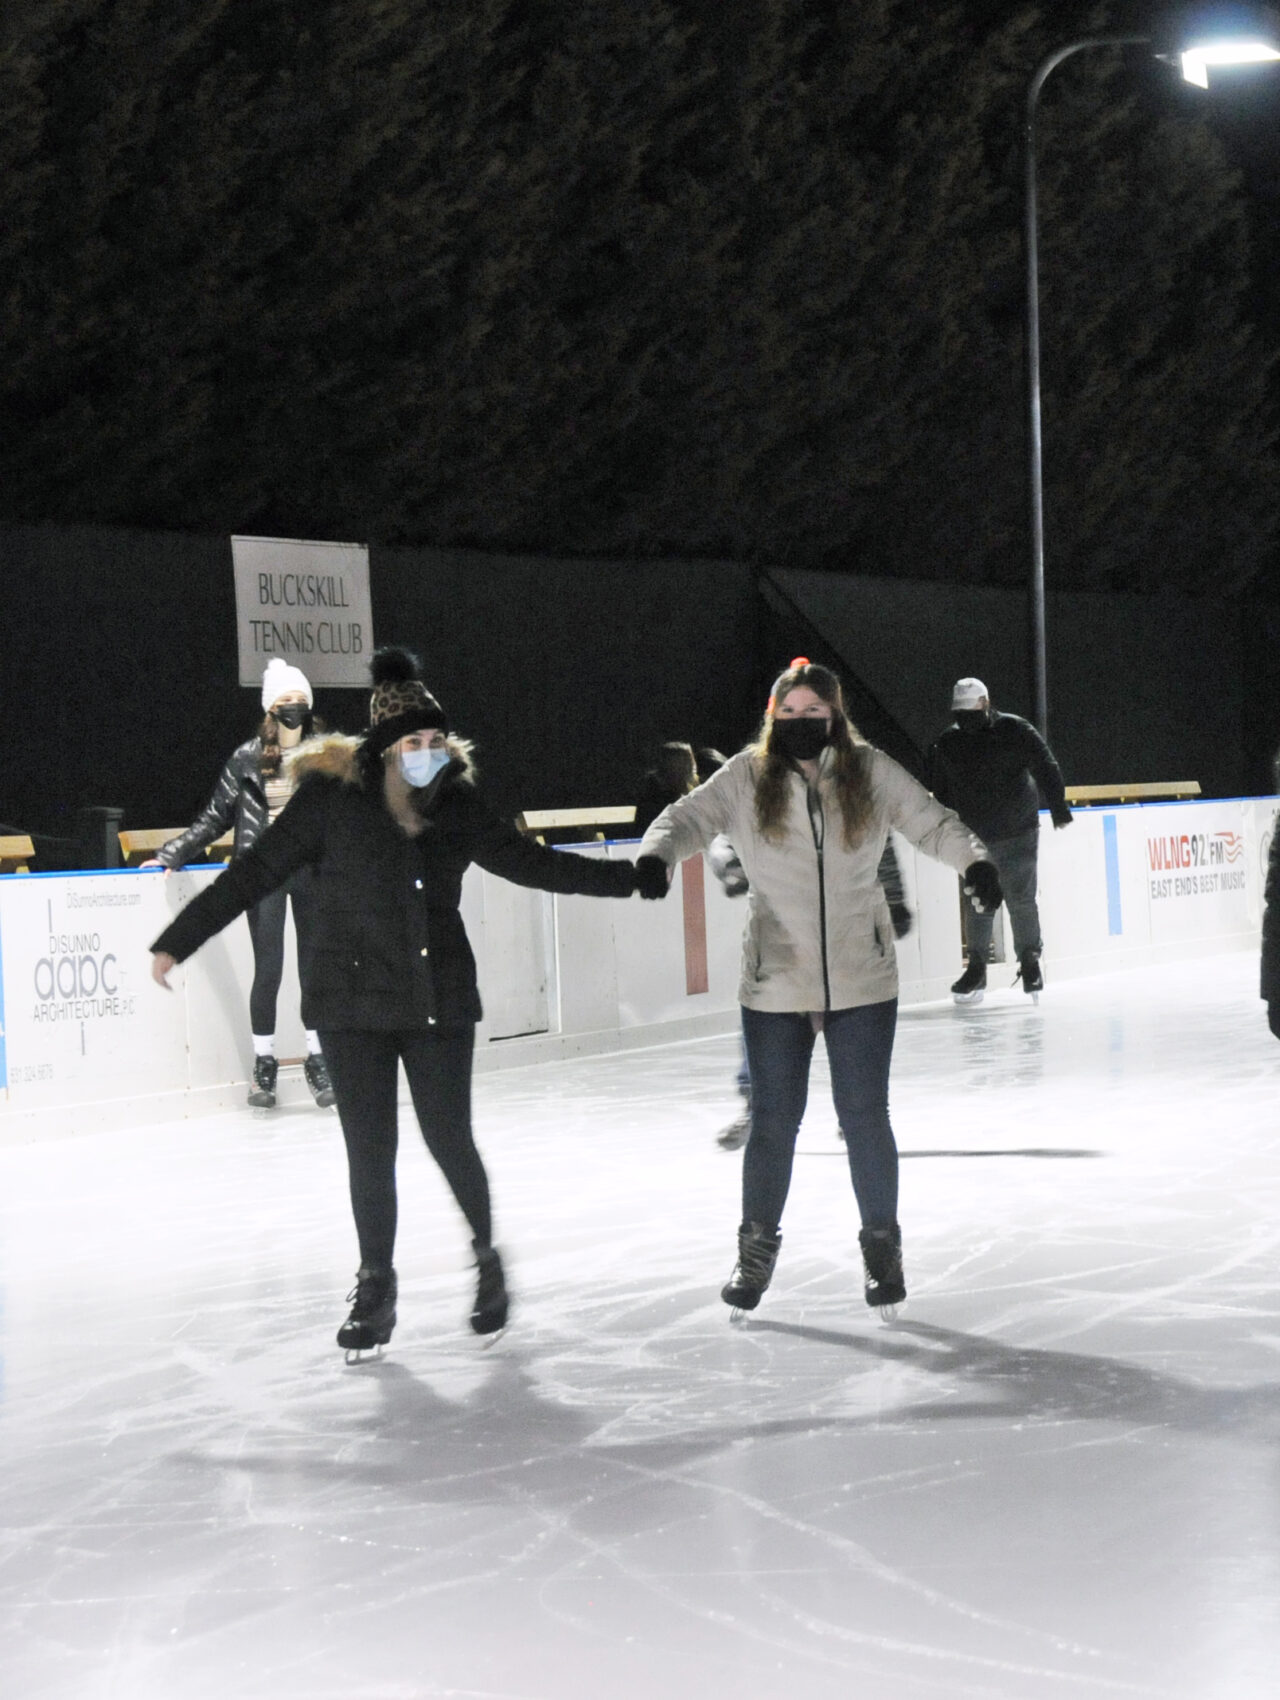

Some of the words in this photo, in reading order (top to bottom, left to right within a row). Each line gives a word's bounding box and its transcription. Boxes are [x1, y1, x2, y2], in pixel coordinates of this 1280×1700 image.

[258, 573, 349, 608] BUCKSKILL
[249, 620, 313, 653] TENNIS
[316, 622, 363, 654] CLUB
[1148, 835, 1191, 871] WLNG
[1151, 878, 1174, 899] EAST
[1175, 876, 1199, 896] END'S
[1200, 873, 1220, 894] BEST
[1221, 871, 1246, 891] MUSIC
[49, 932, 101, 954] DISUNNO
[34, 953, 118, 1001] aapc
